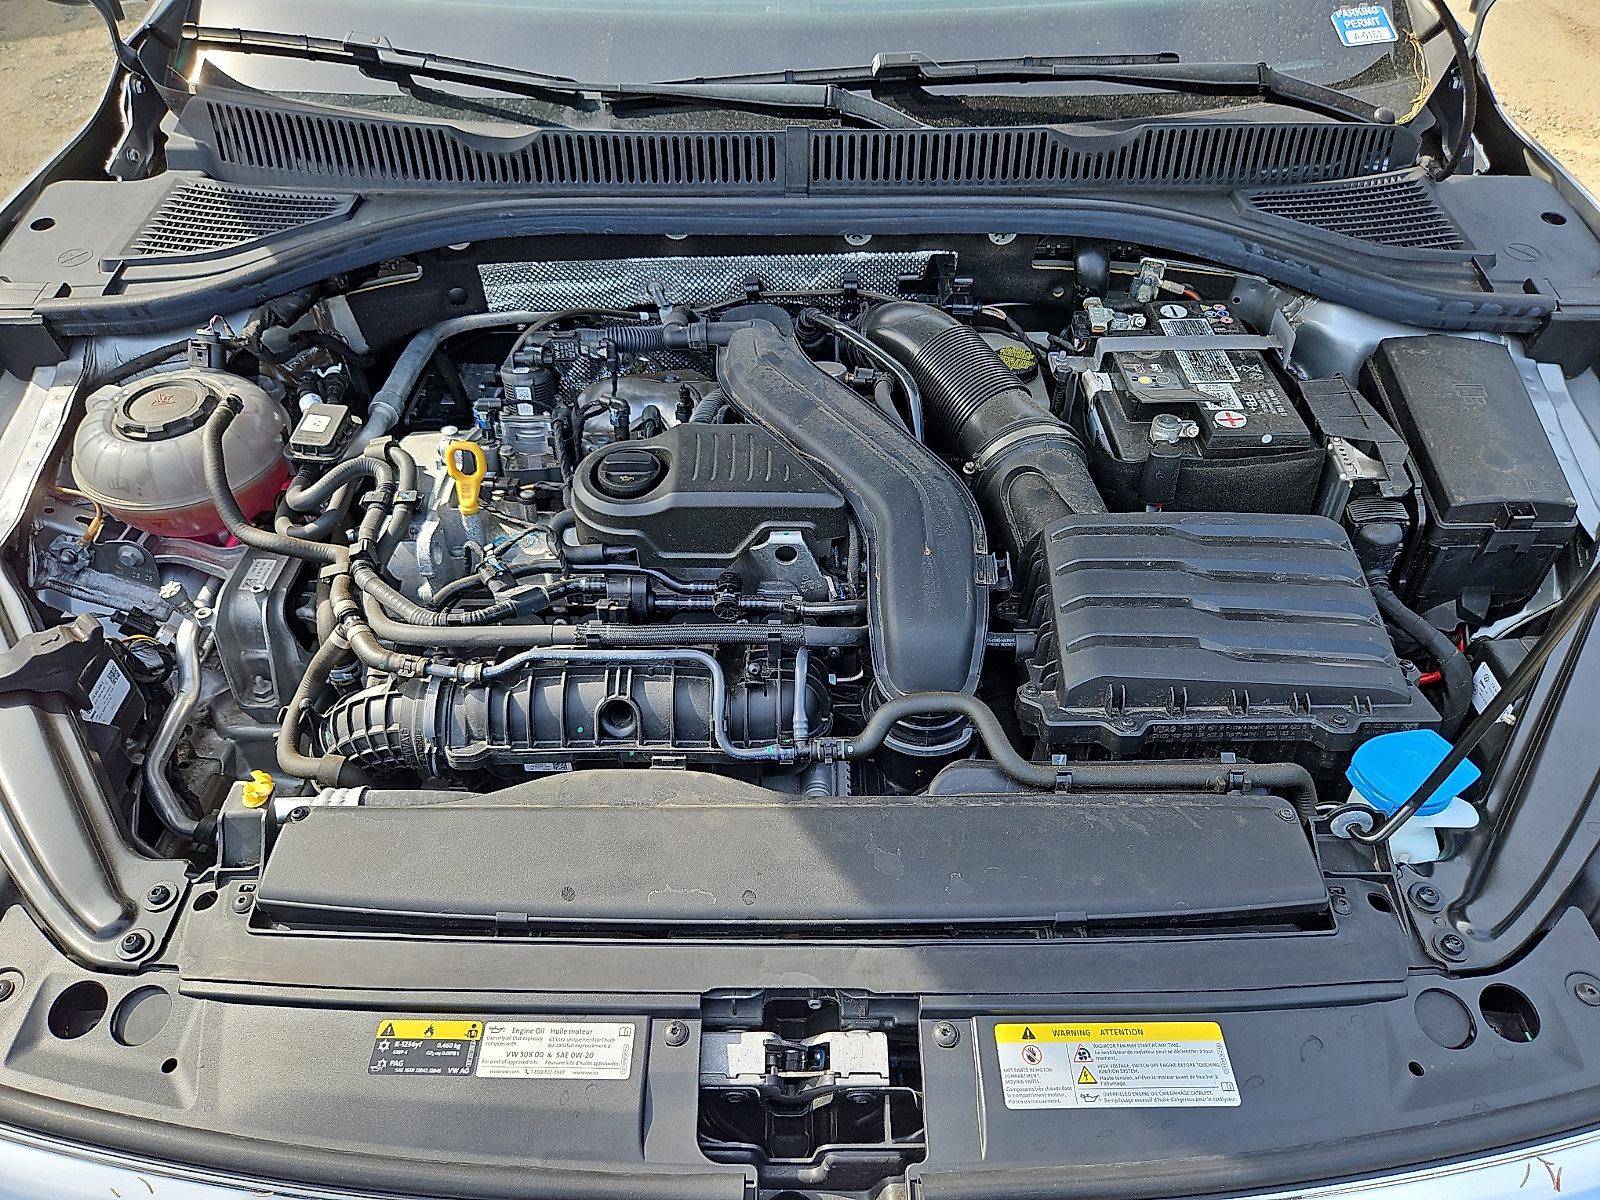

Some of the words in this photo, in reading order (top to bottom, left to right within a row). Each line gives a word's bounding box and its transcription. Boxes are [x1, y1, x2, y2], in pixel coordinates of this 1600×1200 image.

[1335, 6, 1379, 18] PARKING
[1343, 17, 1379, 28] PERMIT
[512, 1028, 534, 1036] Engine
[394, 1041, 423, 1050] R-1234yf
